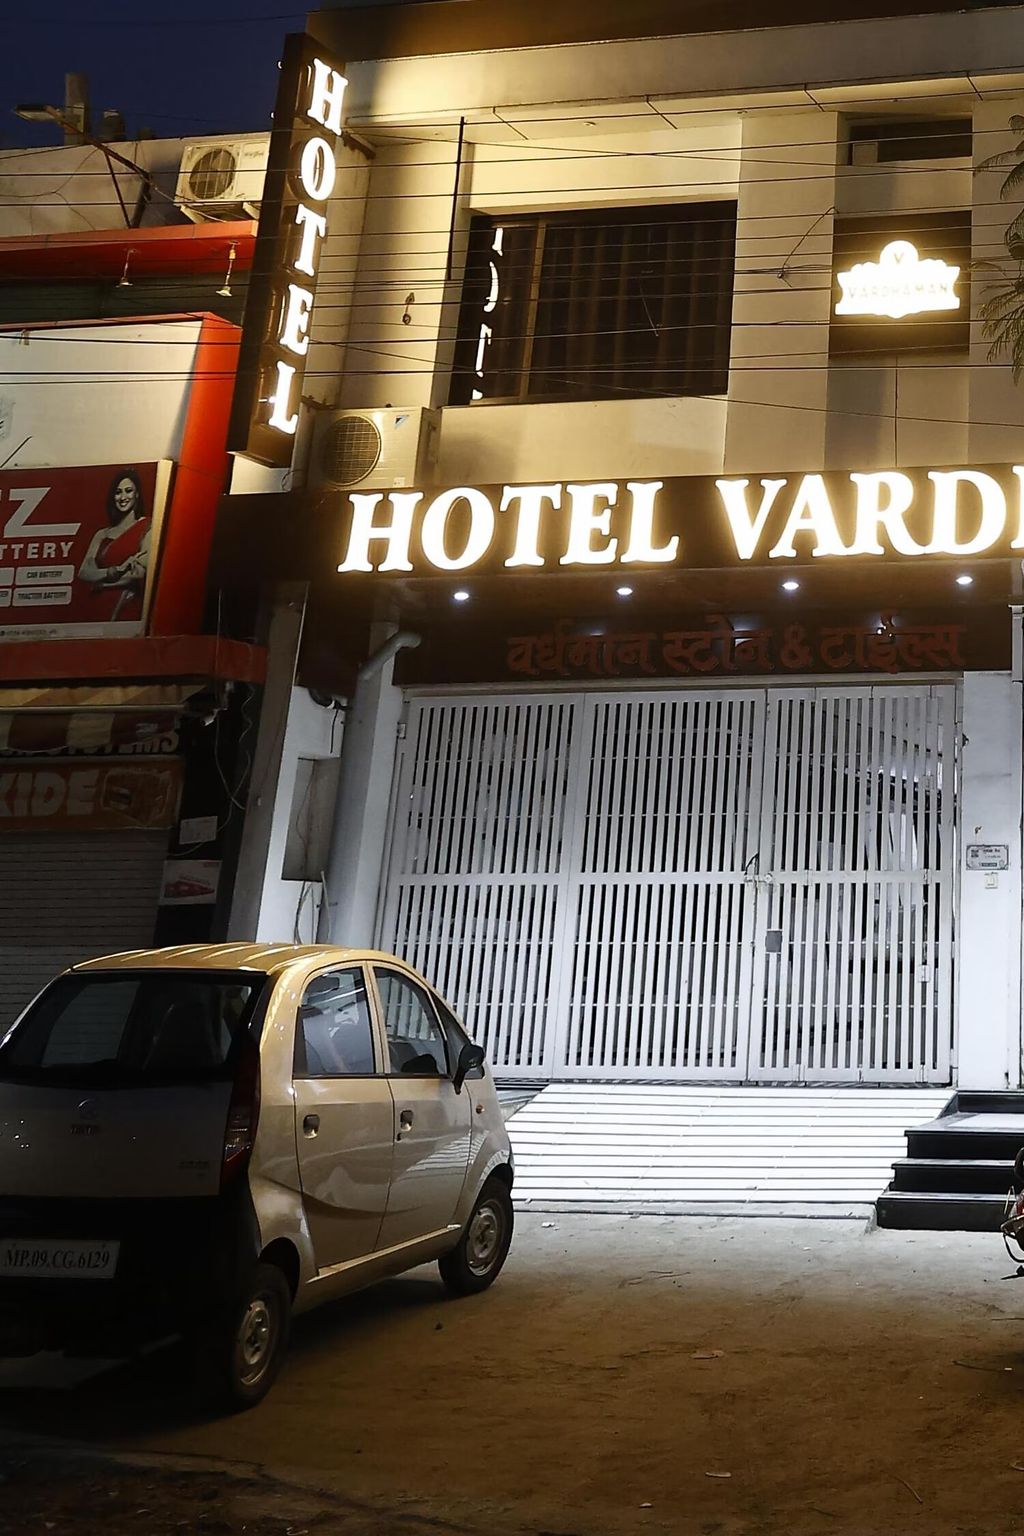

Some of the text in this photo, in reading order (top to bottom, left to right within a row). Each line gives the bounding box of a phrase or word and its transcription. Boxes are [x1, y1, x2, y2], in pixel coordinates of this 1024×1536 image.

[268, 57, 349, 435] HOTEL
[848, 282, 949, 300] VARDHAMAN
[337, 481, 680, 572] HOTEL
[506, 617, 658, 676] वर्धमान
[662, 613, 776, 672] स्टोन
[780, 623, 813, 669] &
